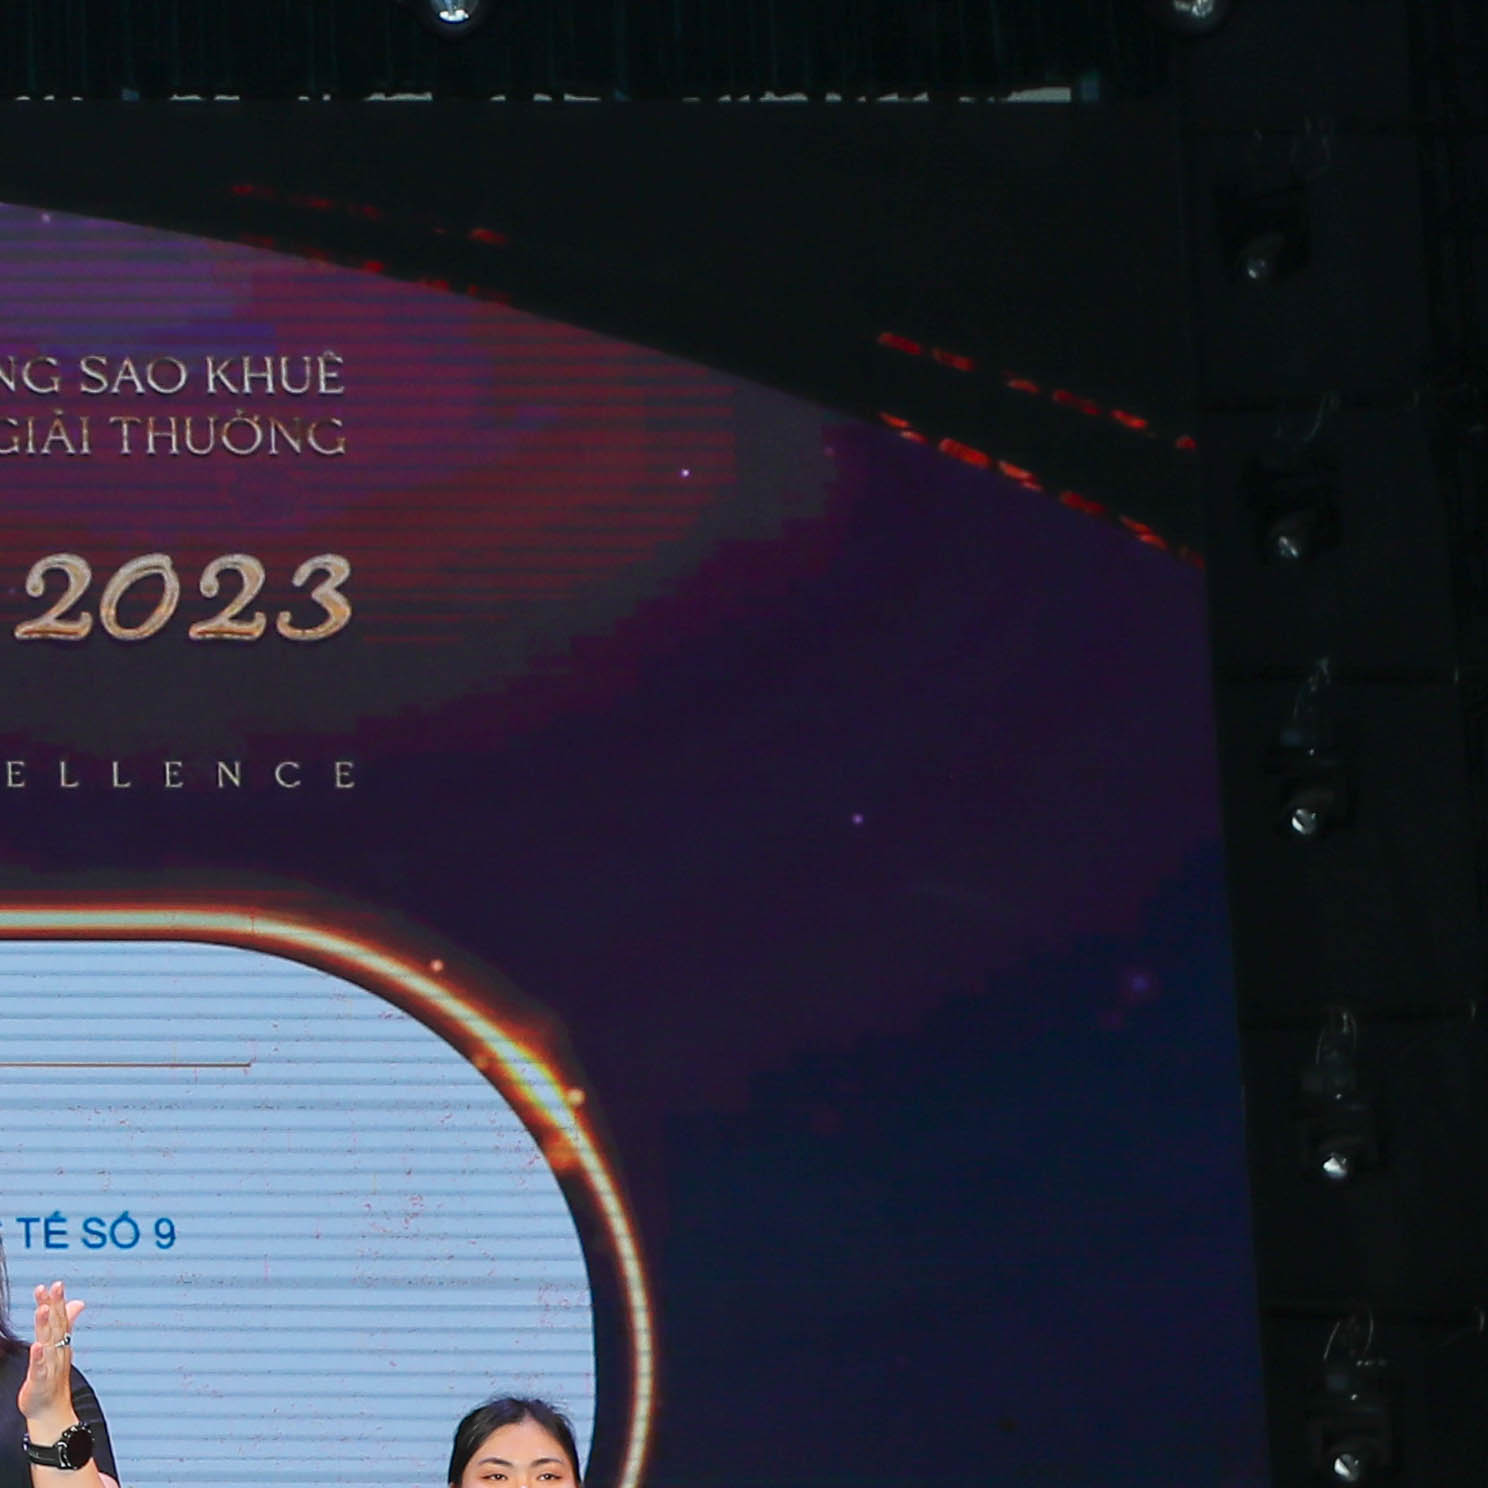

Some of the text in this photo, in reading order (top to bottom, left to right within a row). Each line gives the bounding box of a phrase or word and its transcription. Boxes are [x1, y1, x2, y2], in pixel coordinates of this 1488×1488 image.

[79, 355, 189, 394] SAO
[205, 350, 345, 394] KHUÊ
[13, 551, 354, 643] 2023
[154, 1217, 177, 1250] 9
